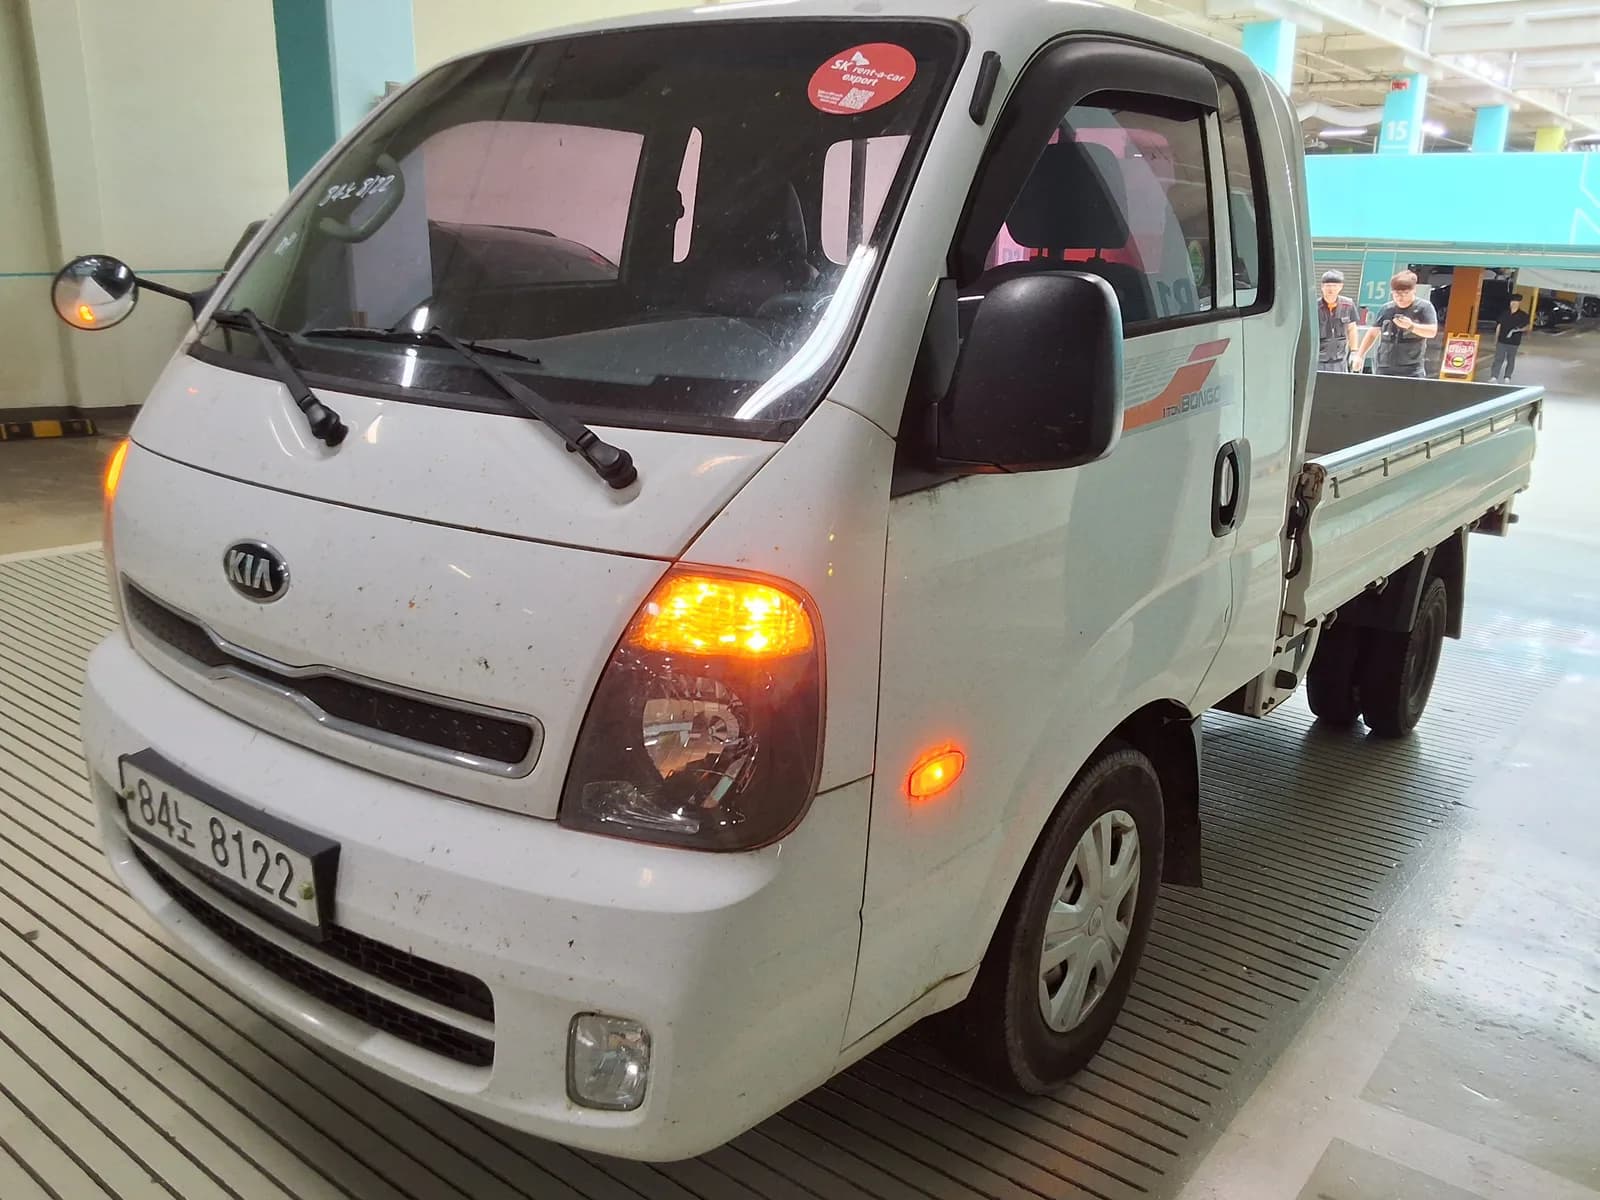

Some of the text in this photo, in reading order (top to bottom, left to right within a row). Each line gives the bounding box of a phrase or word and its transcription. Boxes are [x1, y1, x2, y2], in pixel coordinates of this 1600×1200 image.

[831, 59, 906, 83] SK rent-a-car
[842, 73, 879, 87] export
[1386, 120, 1409, 142] 15
[1366, 280, 1387, 300] 15
[229, 549, 274, 593] KIA
[137, 778, 298, 908] 84노 8122
